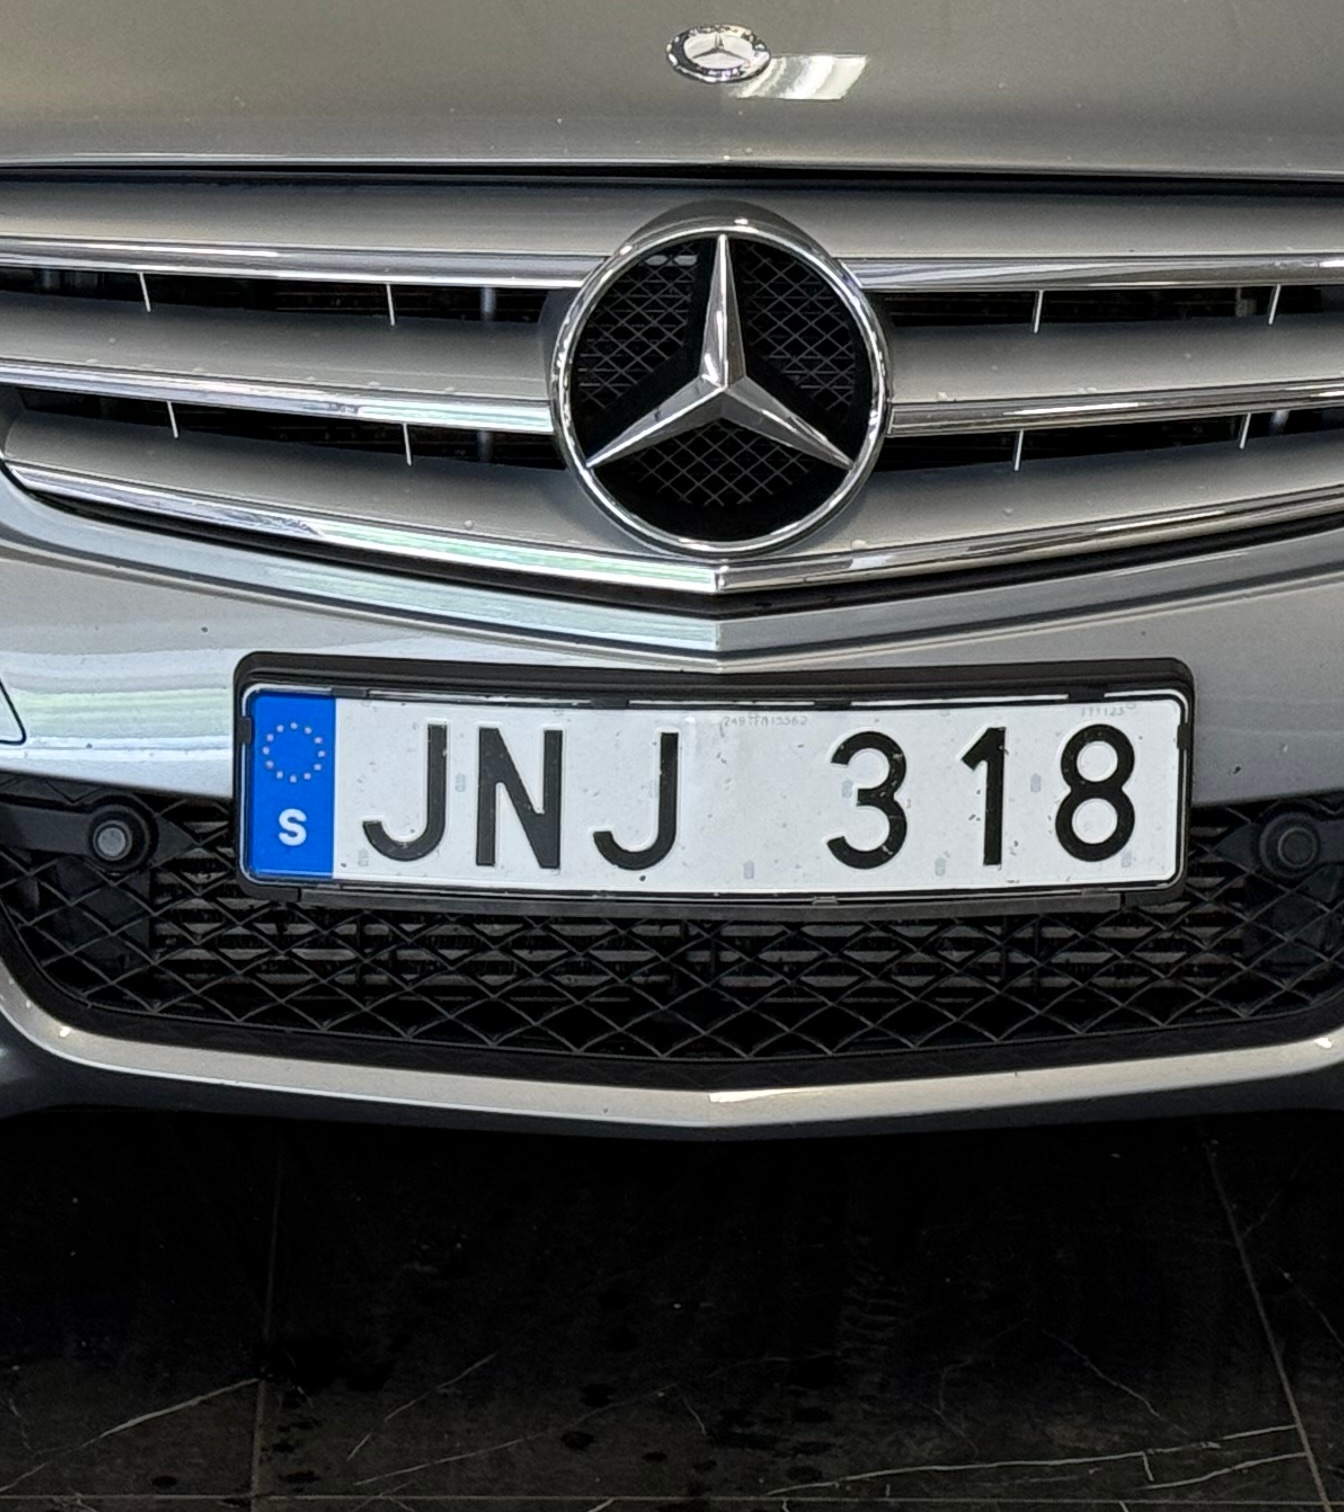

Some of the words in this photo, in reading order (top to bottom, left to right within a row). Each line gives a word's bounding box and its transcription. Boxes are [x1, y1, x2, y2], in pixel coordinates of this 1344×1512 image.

[278, 808, 307, 847] S
[362, 722, 679, 872] JNJ
[825, 722, 1136, 870] 318
